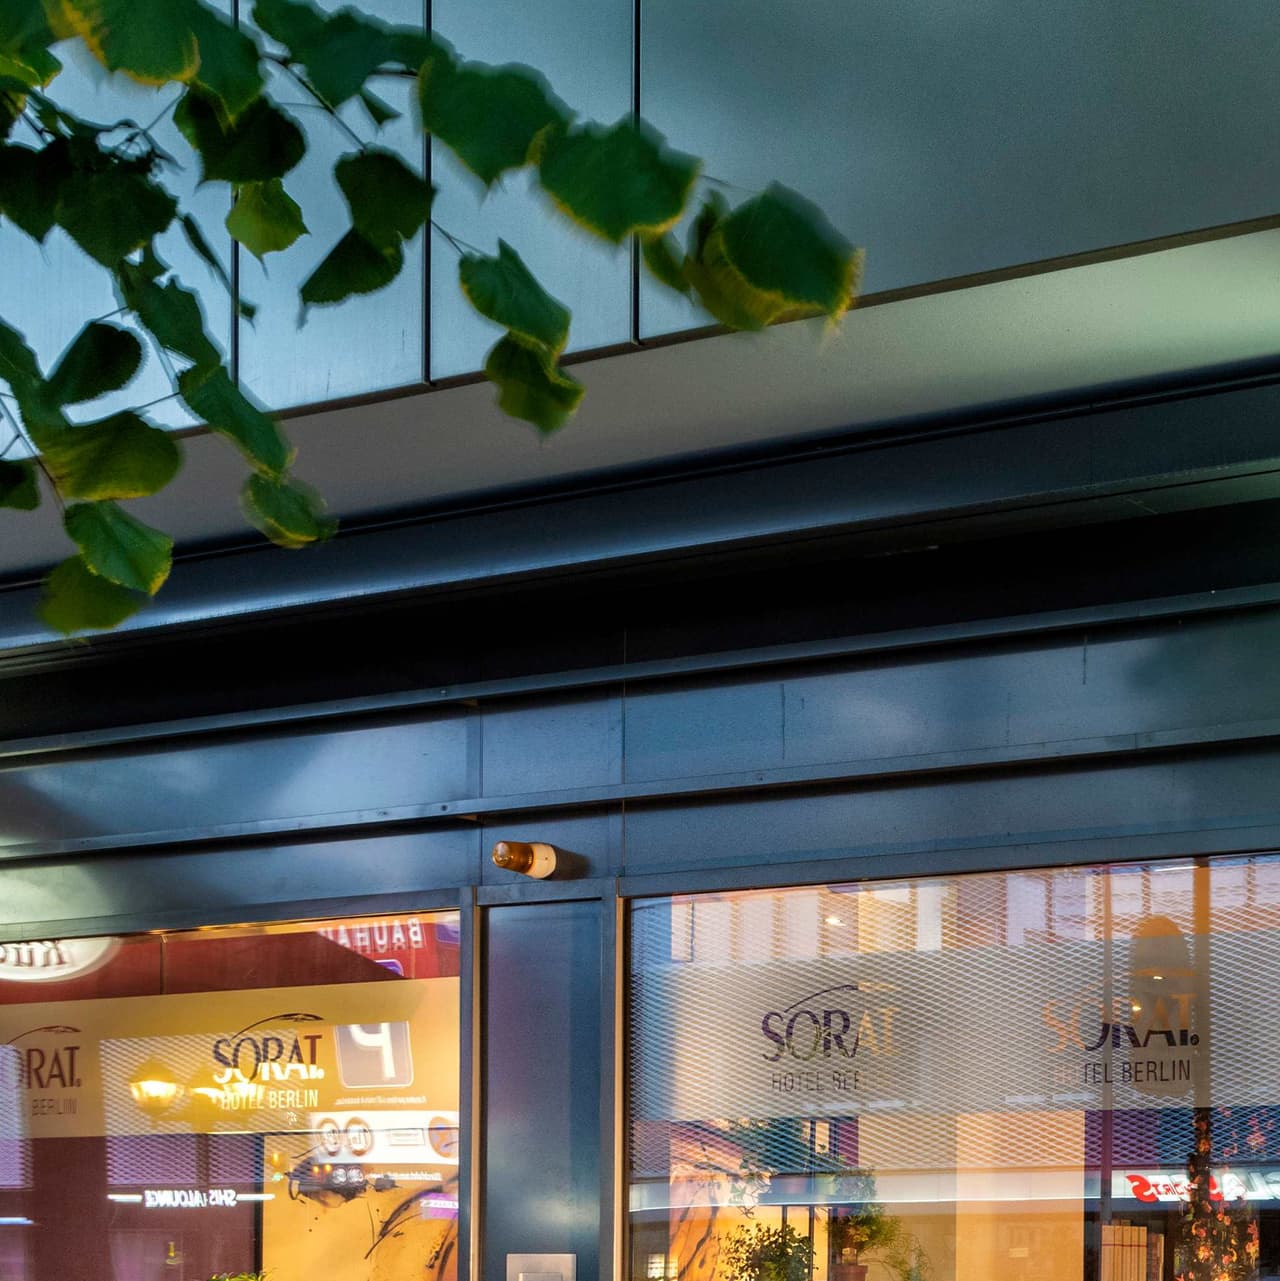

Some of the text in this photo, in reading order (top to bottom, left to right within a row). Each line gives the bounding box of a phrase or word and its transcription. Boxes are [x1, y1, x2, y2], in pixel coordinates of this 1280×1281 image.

[761, 1006, 899, 1062] SORAT
[213, 1034, 324, 1084] SORAT
[1122, 1059, 1191, 1082] BERLIN
[269, 1089, 319, 1110] BERLIN
